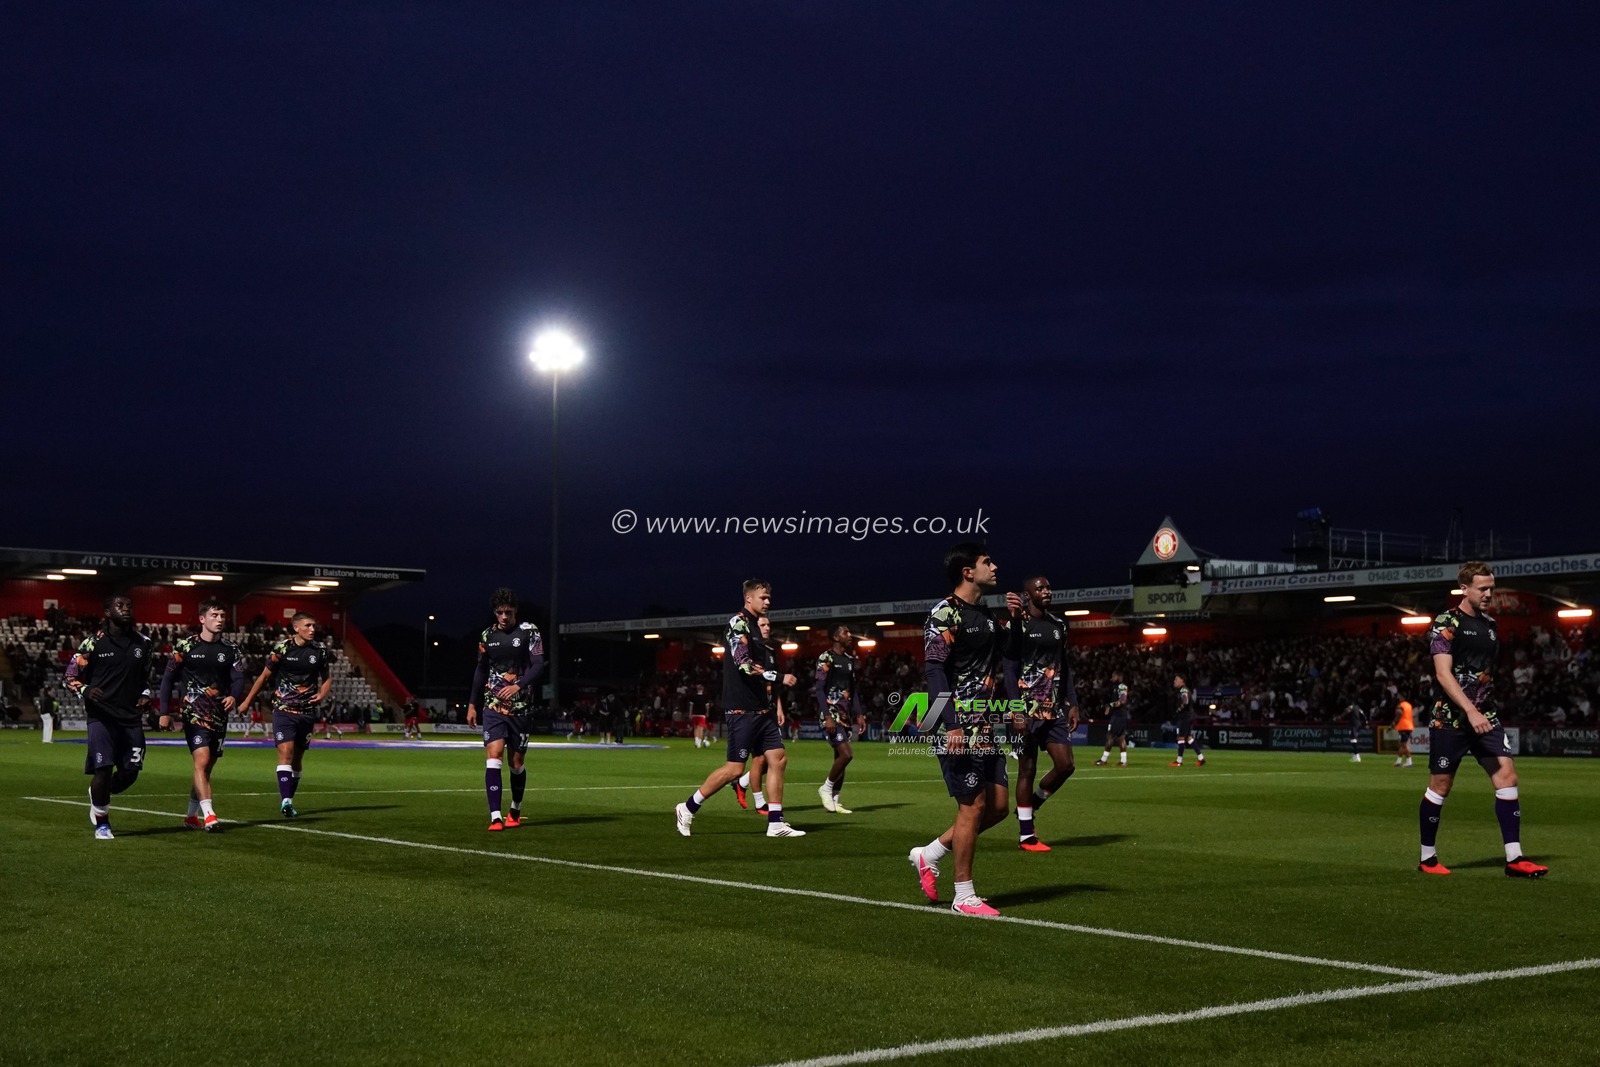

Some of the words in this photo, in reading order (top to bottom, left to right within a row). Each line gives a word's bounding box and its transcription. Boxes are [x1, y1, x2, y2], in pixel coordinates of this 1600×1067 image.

[121, 557, 230, 571] ELECTRONICS
[356, 571, 400, 580] Investments
[1287, 573, 1355, 586] Coaches
[1369, 572, 1399, 583] 01462
[1076, 587, 1131, 599] Coaches
[1147, 592, 1187, 605] SPORTA
[1285, 729, 1322, 738] COPPING
[1550, 729, 1599, 740] LINCOLNS
